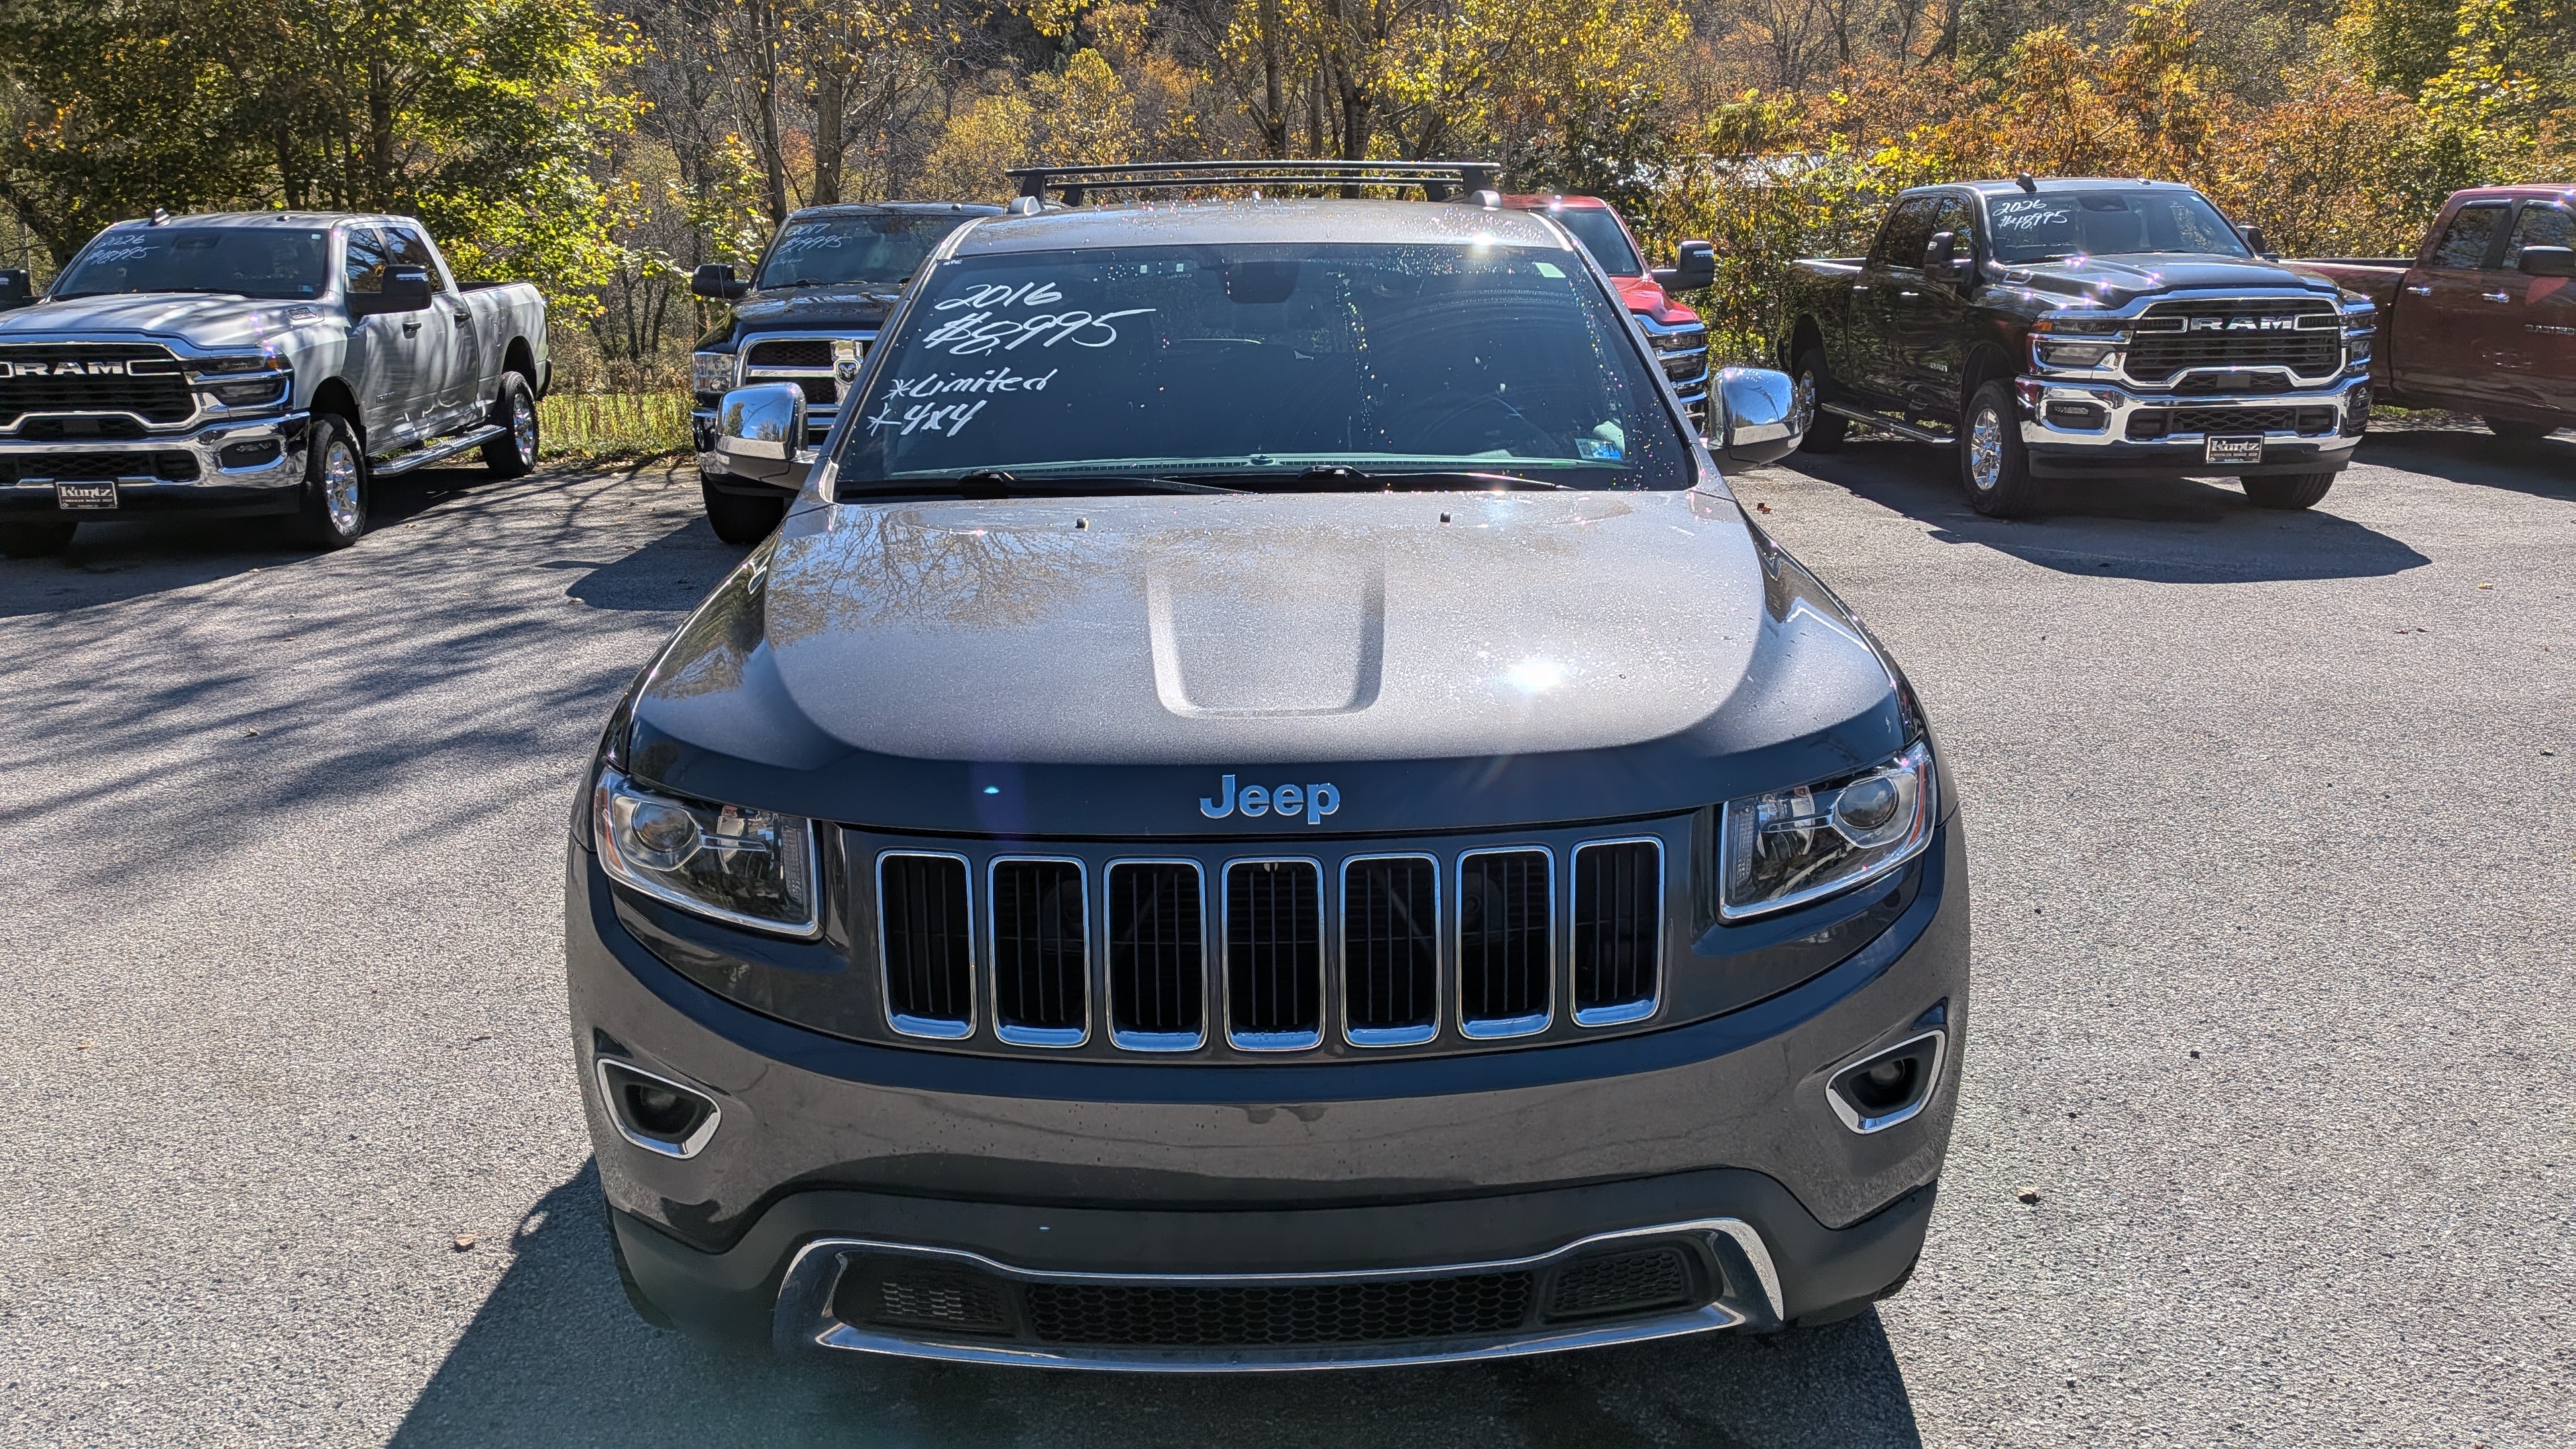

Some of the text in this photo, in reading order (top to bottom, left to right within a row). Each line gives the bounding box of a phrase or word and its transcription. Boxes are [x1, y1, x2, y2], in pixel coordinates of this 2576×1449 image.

[1992, 199, 2047, 217] 2026
[785, 223, 831, 237] 2017
[94, 235, 145, 248] 2026
[934, 282, 1062, 310] 2016
[2190, 316, 2293, 331] RAM
[14, 362, 123, 376] RAM
[60, 486, 113, 498] Kuntz
[1199, 774, 1340, 825] Jeep
